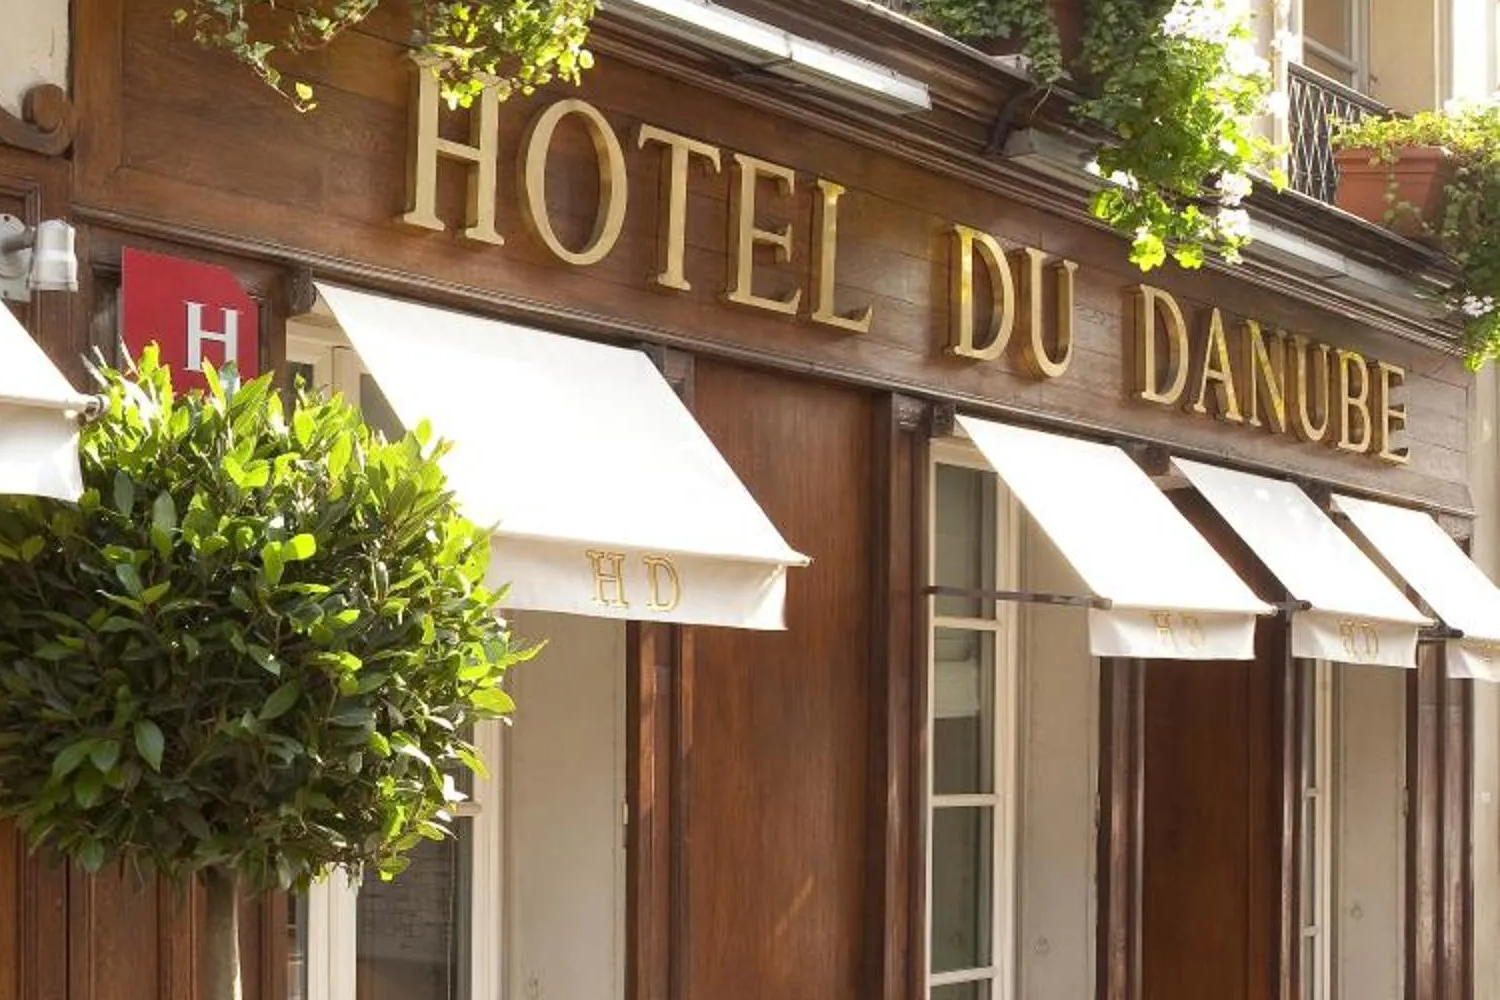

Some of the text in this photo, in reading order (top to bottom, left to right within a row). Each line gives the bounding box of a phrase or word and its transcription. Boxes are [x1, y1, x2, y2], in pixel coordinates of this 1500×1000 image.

[182, 299, 244, 372] H
[401, 49, 1411, 465] HOTEL DU DANUBE
